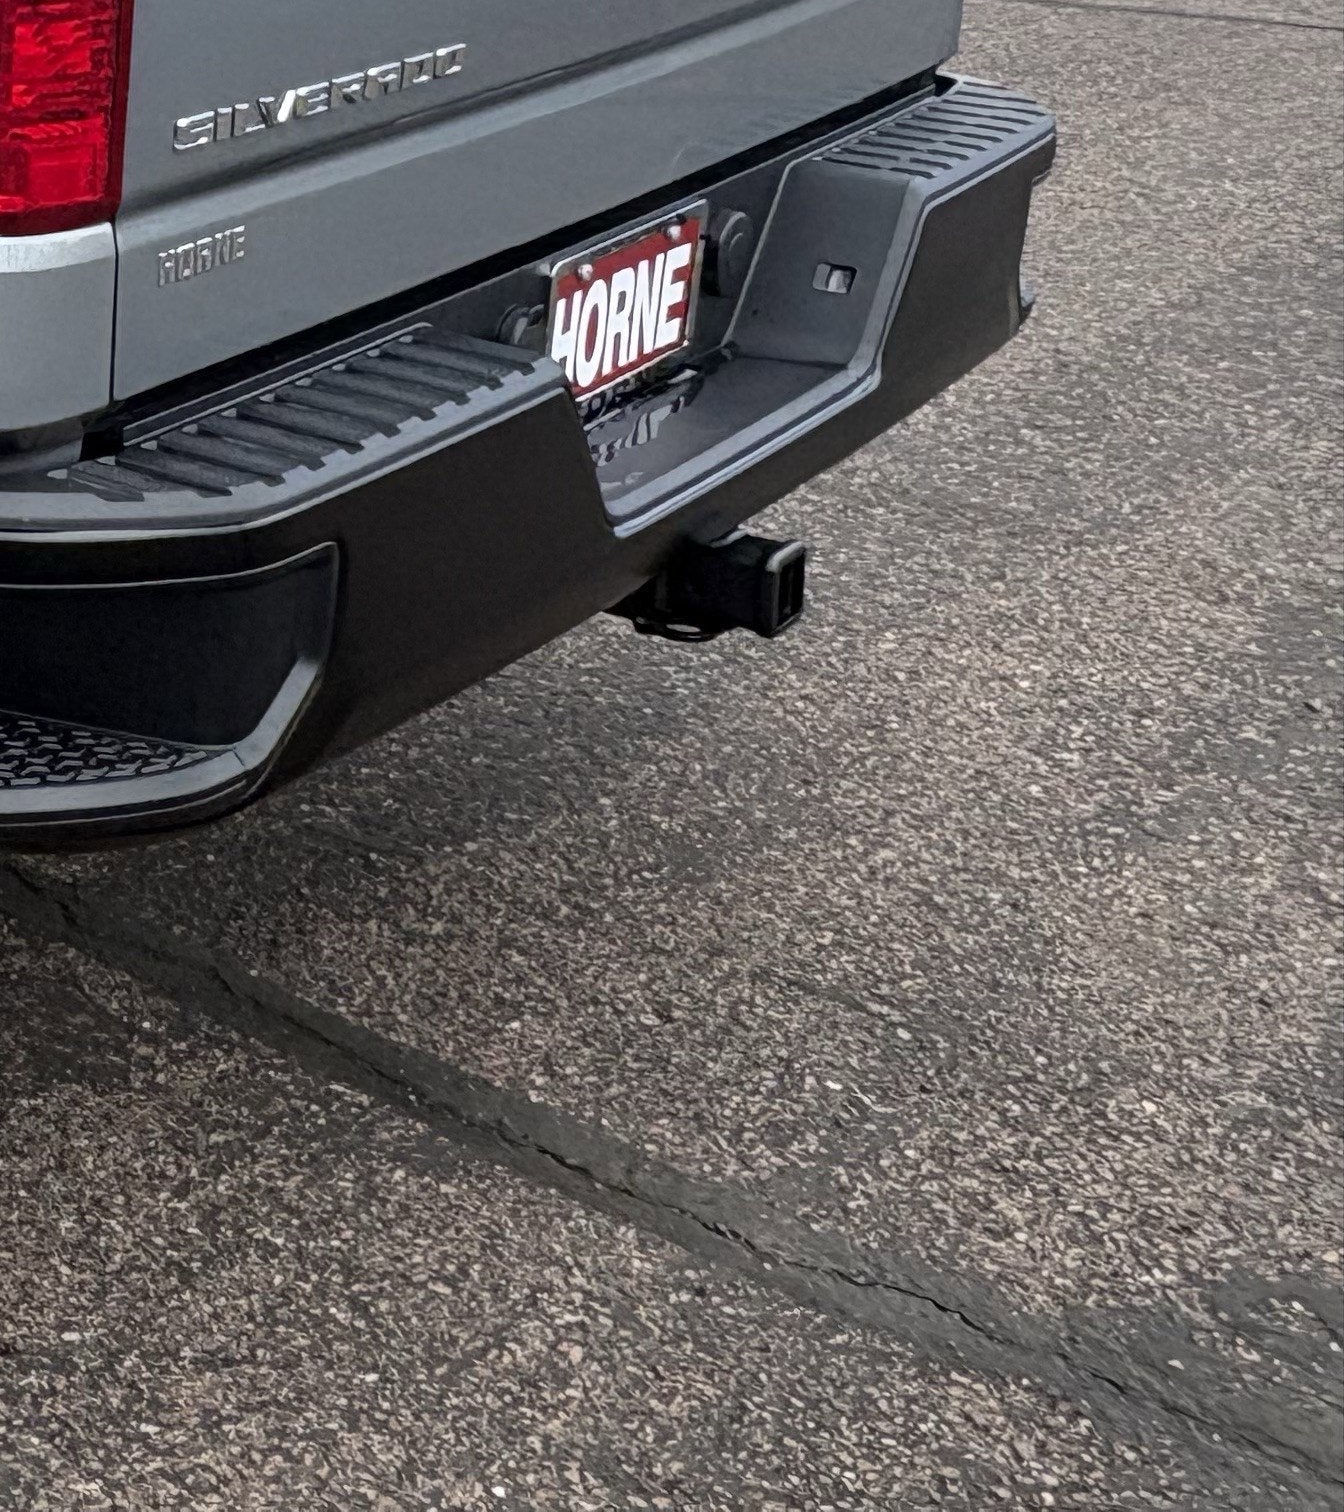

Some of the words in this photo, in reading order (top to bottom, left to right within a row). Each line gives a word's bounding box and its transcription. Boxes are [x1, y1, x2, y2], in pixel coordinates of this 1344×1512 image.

[172, 42, 467, 151] SILVERADO
[157, 224, 246, 288] HORNE
[550, 242, 692, 389] HORNE
